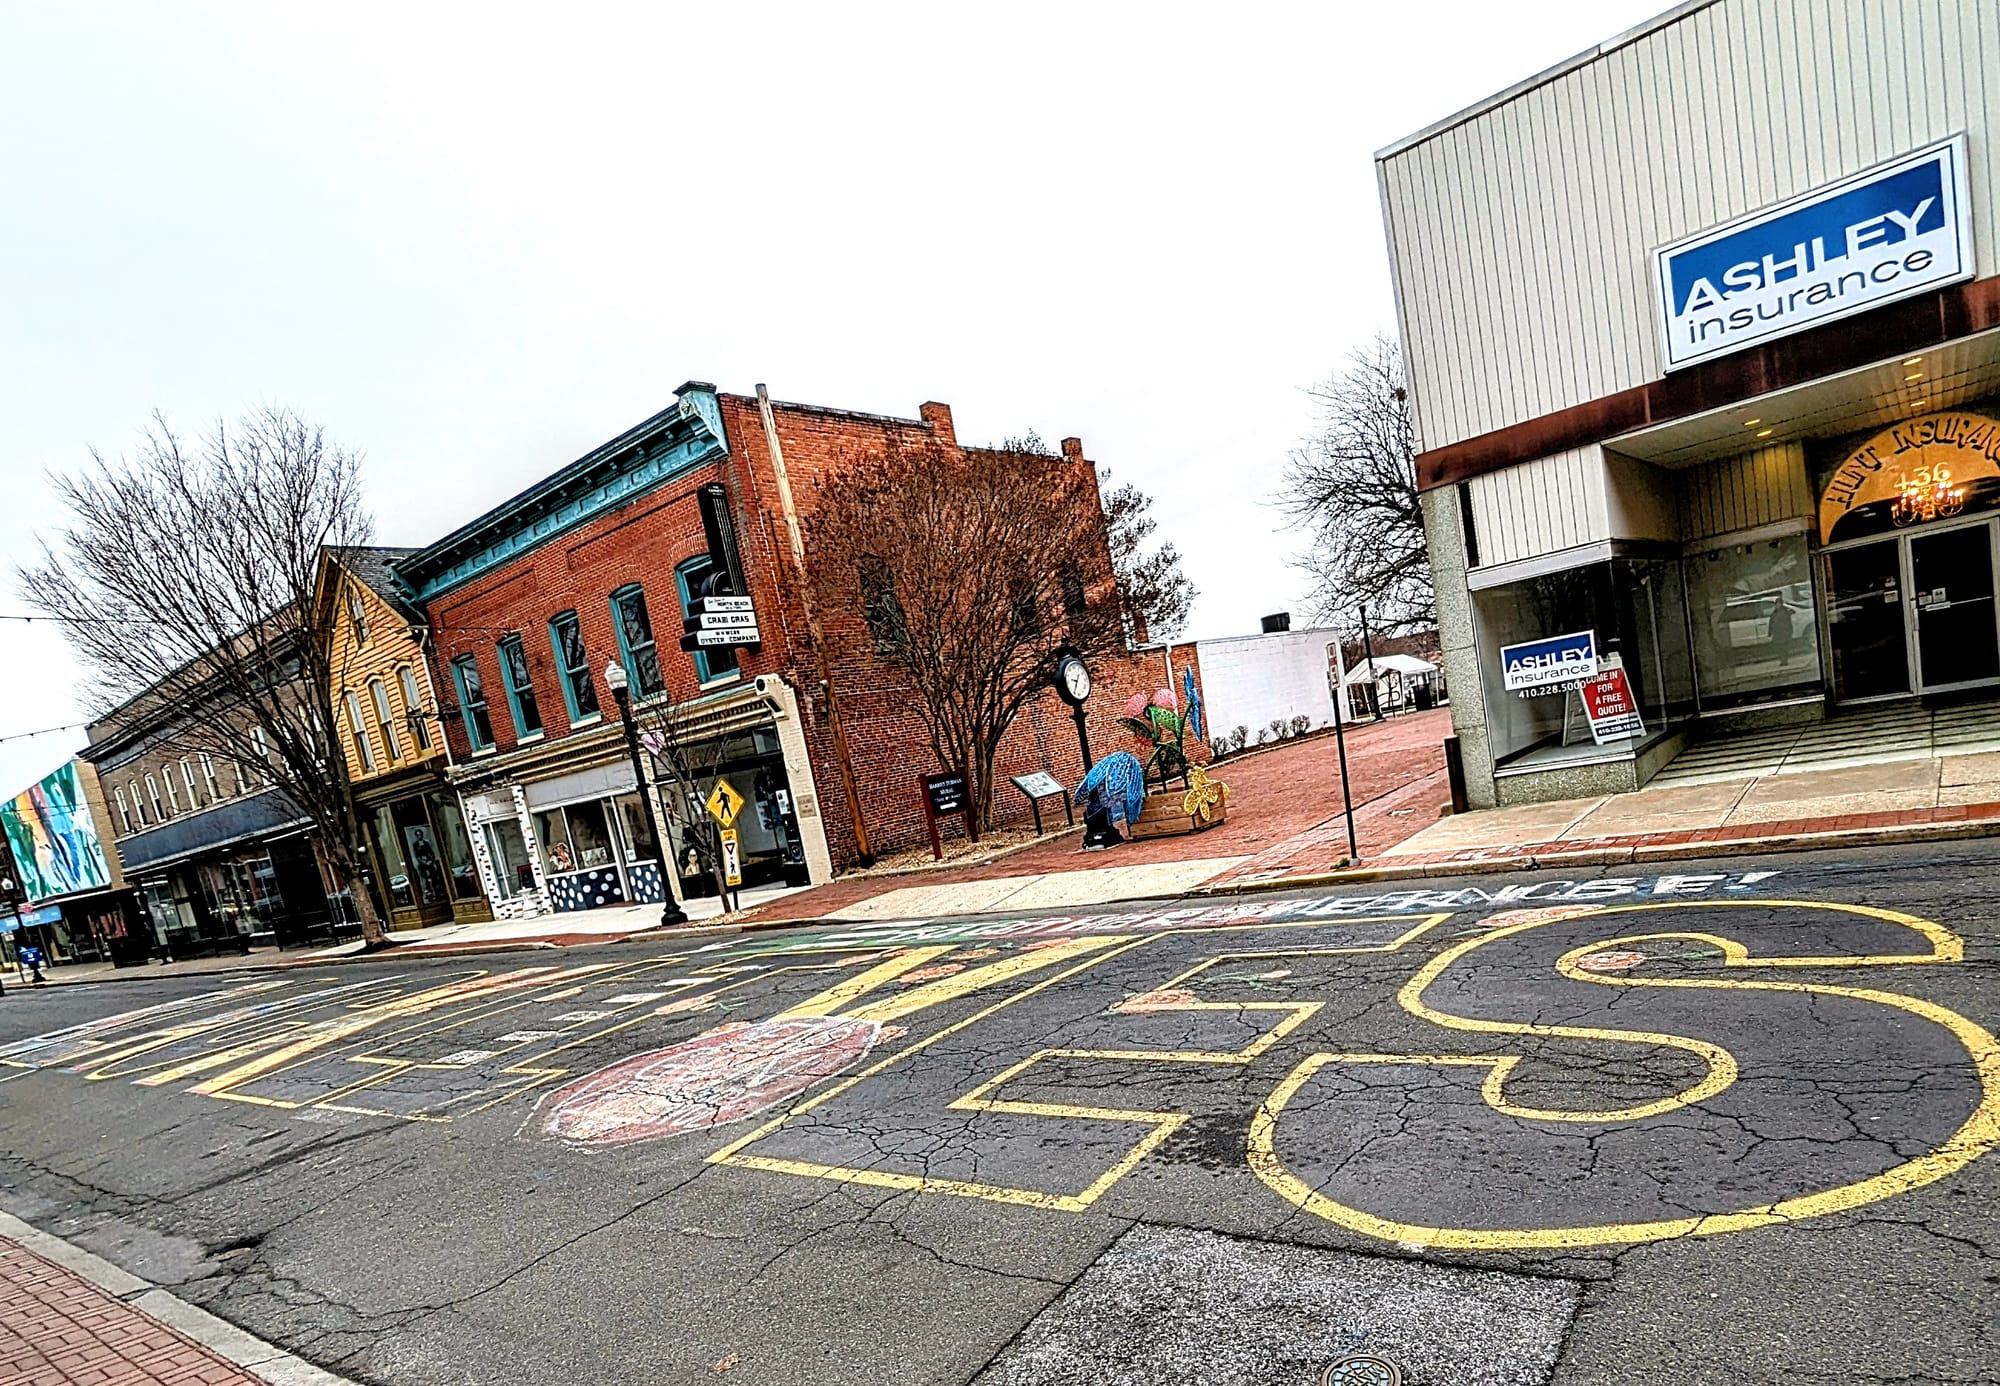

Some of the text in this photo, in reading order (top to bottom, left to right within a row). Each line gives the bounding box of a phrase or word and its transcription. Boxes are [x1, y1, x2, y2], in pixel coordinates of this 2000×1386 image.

[1680, 195, 1936, 317] ASHLEY
[1689, 245, 1933, 344] insurance
[1894, 462, 1951, 489] 436
[1506, 646, 1590, 673] ASHLEY
[1511, 664, 1590, 685] insurance
[1610, 671, 1618, 679] IN
[1518, 680, 1586, 699] 410.228.5000
[1598, 683, 1613, 693] FOR
[1596, 692, 1622, 705] A FREE
[1598, 703, 1626, 716] QUOTE!
